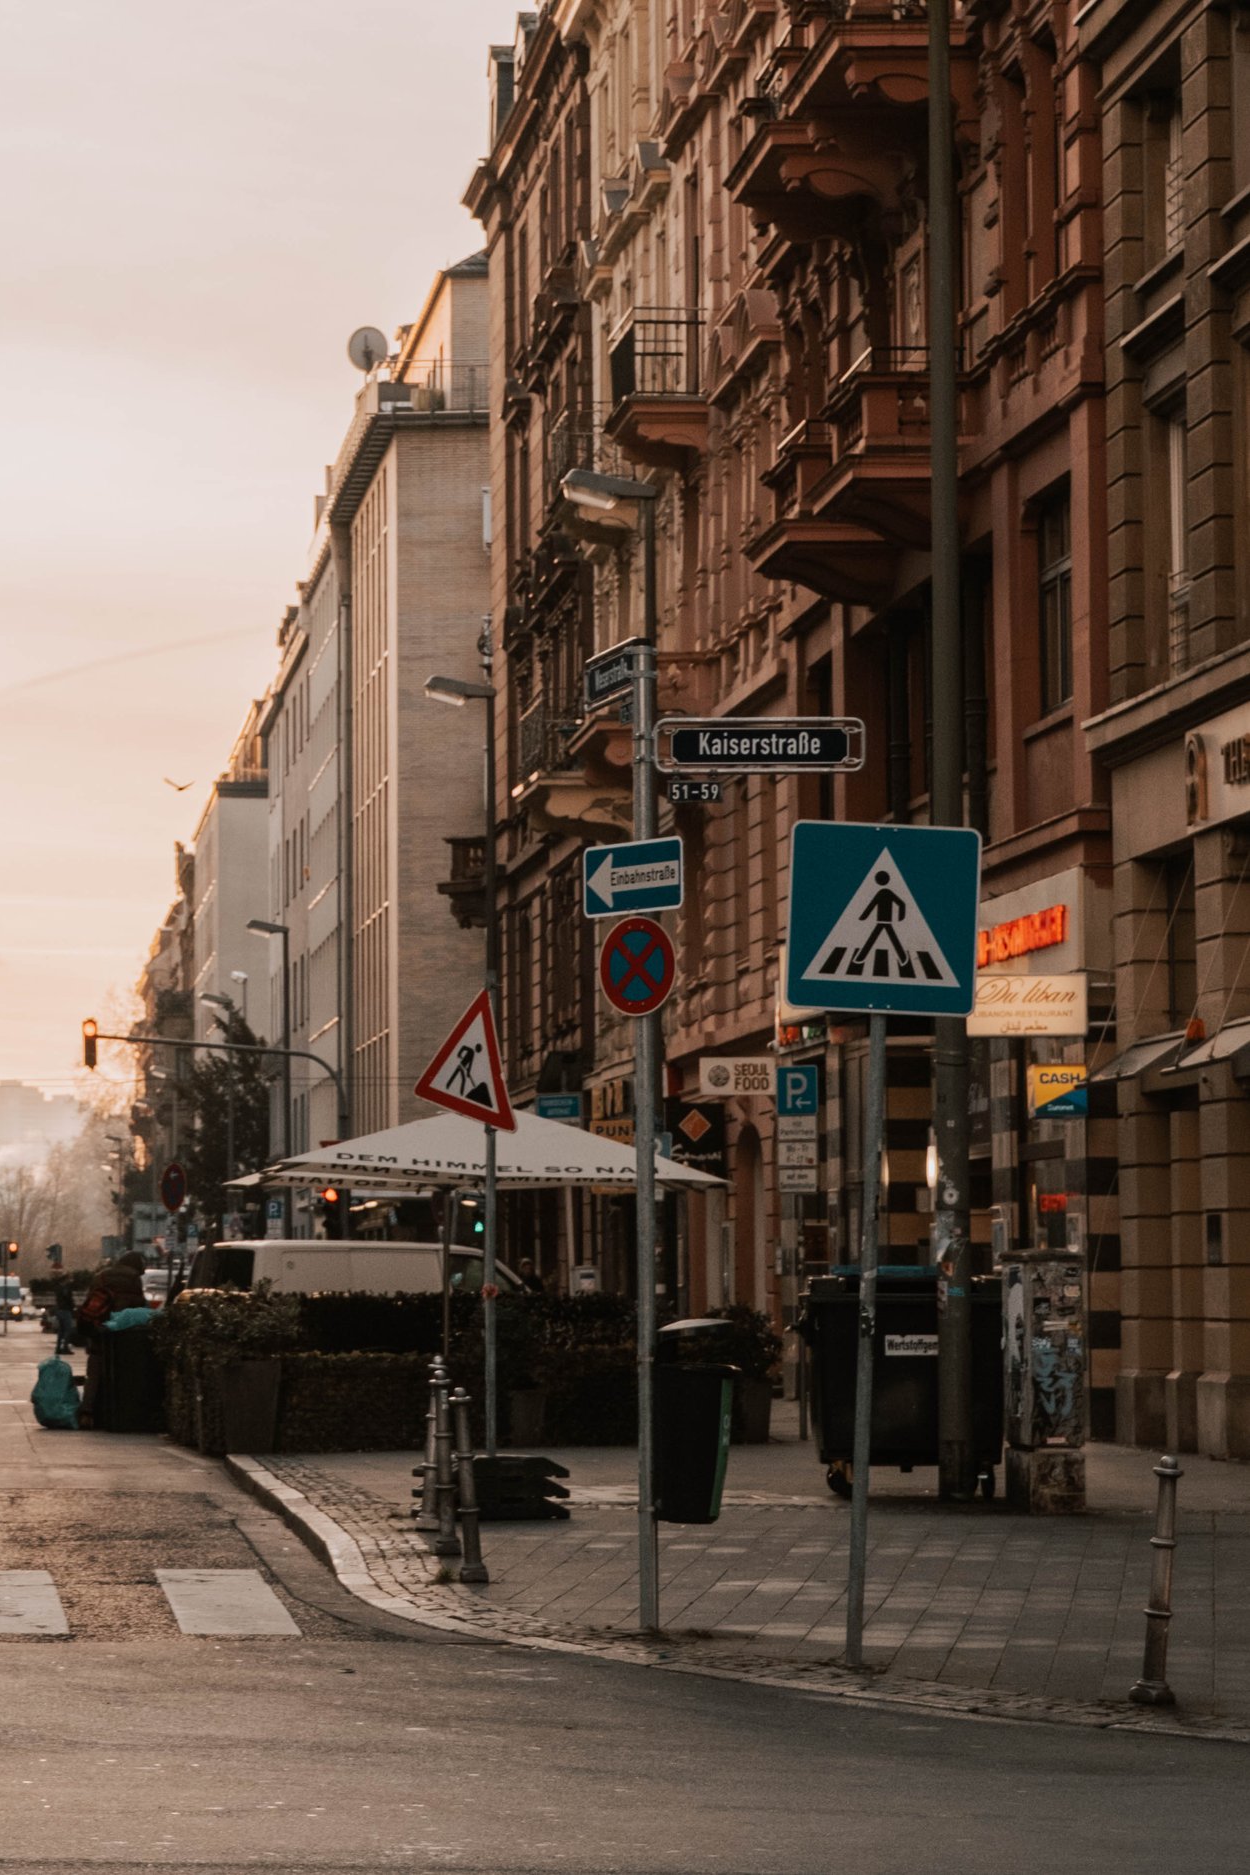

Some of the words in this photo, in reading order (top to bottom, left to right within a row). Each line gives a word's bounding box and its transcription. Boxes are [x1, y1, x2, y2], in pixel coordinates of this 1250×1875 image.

[699, 731, 821, 755] Kaiserstraße
[672, 784, 719, 799] 51-59
[611, 865, 676, 887] Einbahnstraße
[734, 1063, 769, 1076] SEOUL
[1039, 1072, 1081, 1084] CASH
[734, 1076, 769, 1090] FOOD
[786, 1072, 807, 1109] P
[336, 1153, 398, 1163] DEM
[412, 1158, 533, 1173] HIMMEL
[596, 1166, 659, 1174] NA
